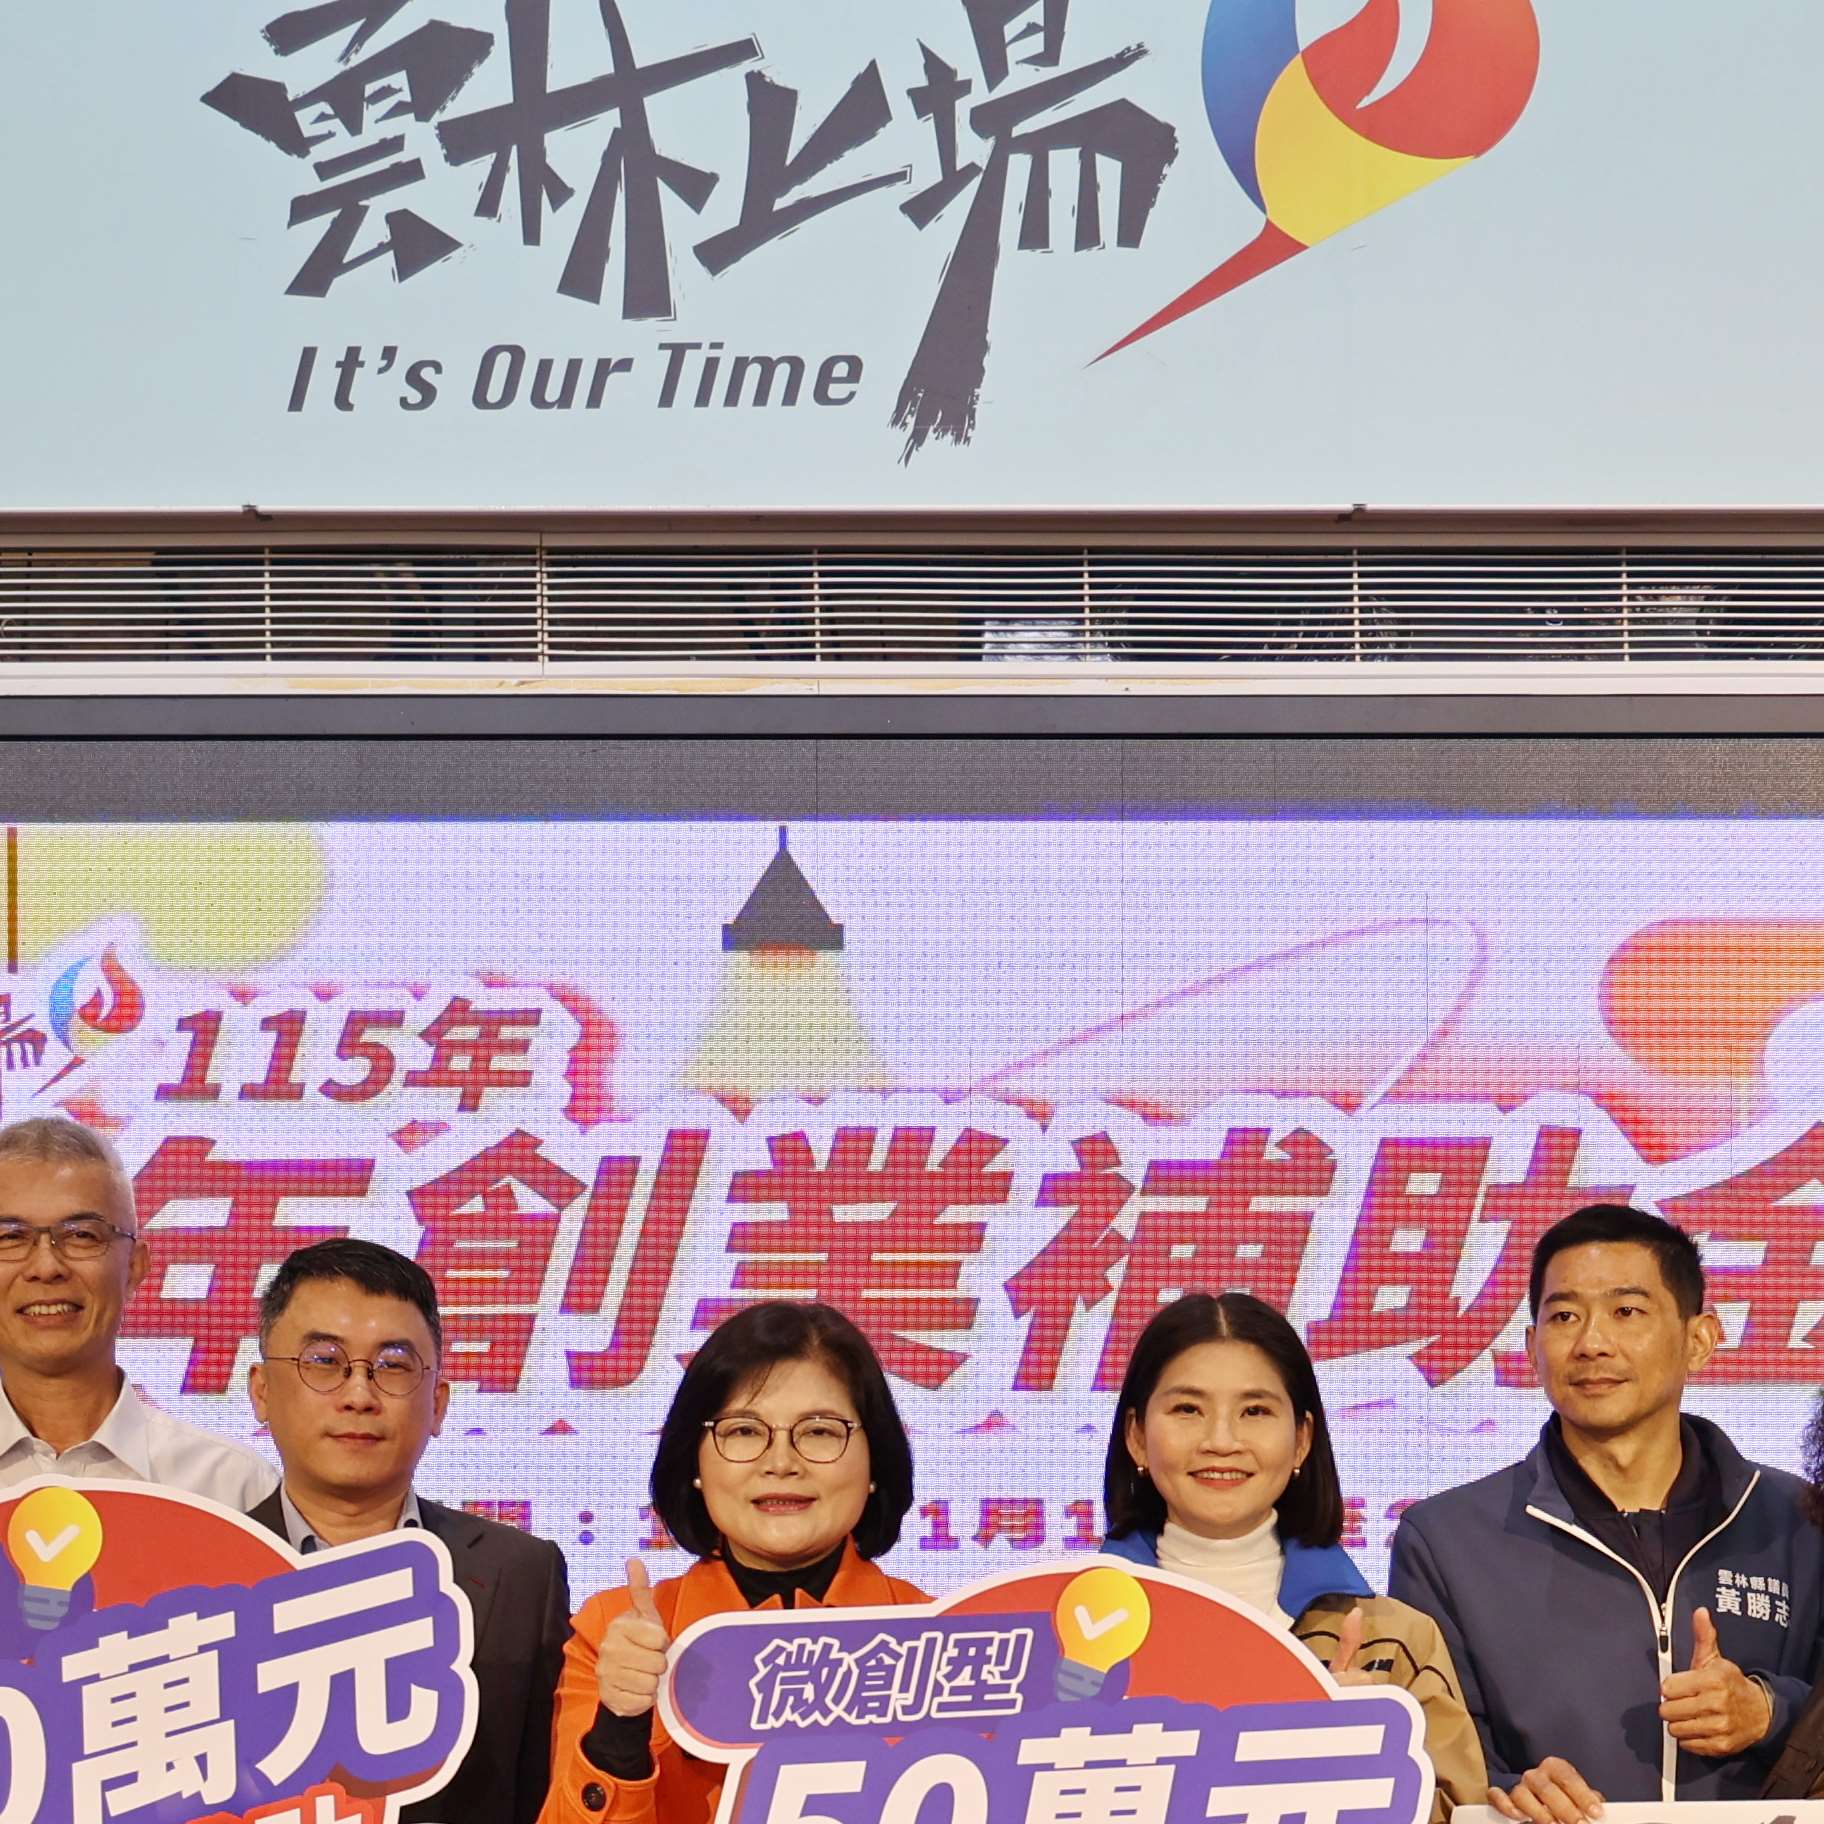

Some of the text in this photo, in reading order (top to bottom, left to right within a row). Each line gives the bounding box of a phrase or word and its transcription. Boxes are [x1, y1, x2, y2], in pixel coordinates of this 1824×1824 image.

[287, 340, 865, 416] It's Our Time
[153, 997, 547, 1112] 115年
[1716, 1587, 1790, 1628] 黃勝志
[749, 1629, 1033, 1729] 微創型
